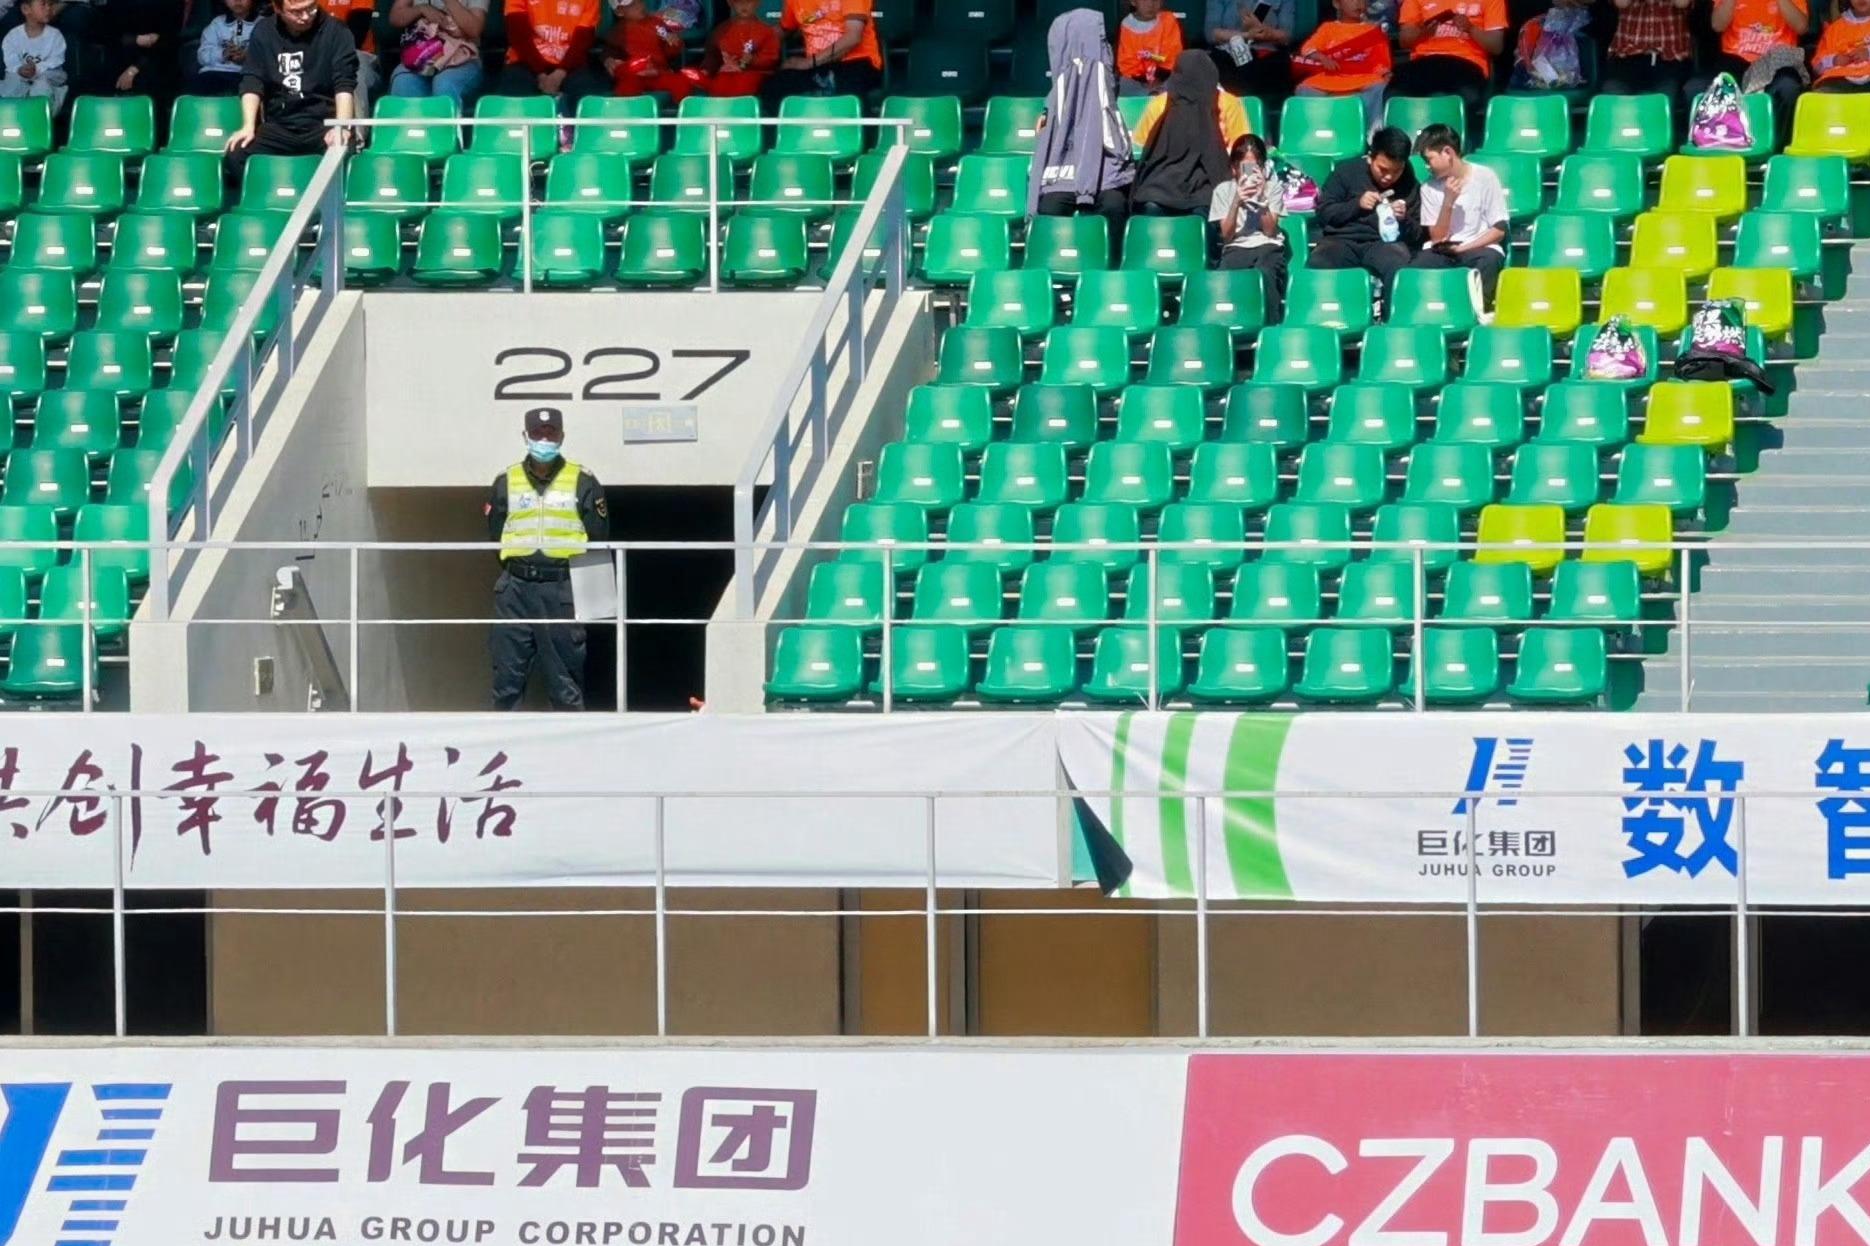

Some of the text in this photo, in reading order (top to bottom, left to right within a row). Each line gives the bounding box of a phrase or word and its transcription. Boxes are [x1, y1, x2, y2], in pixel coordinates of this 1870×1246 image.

[494, 346, 751, 401] 227
[1417, 829, 1557, 857] 巨化集团
[1492, 863, 1557, 877] GROUP
[208, 1079, 818, 1191] 巨化集团
[204, 1215, 338, 1242] JUHUA
[360, 1216, 497, 1244] GROUP
